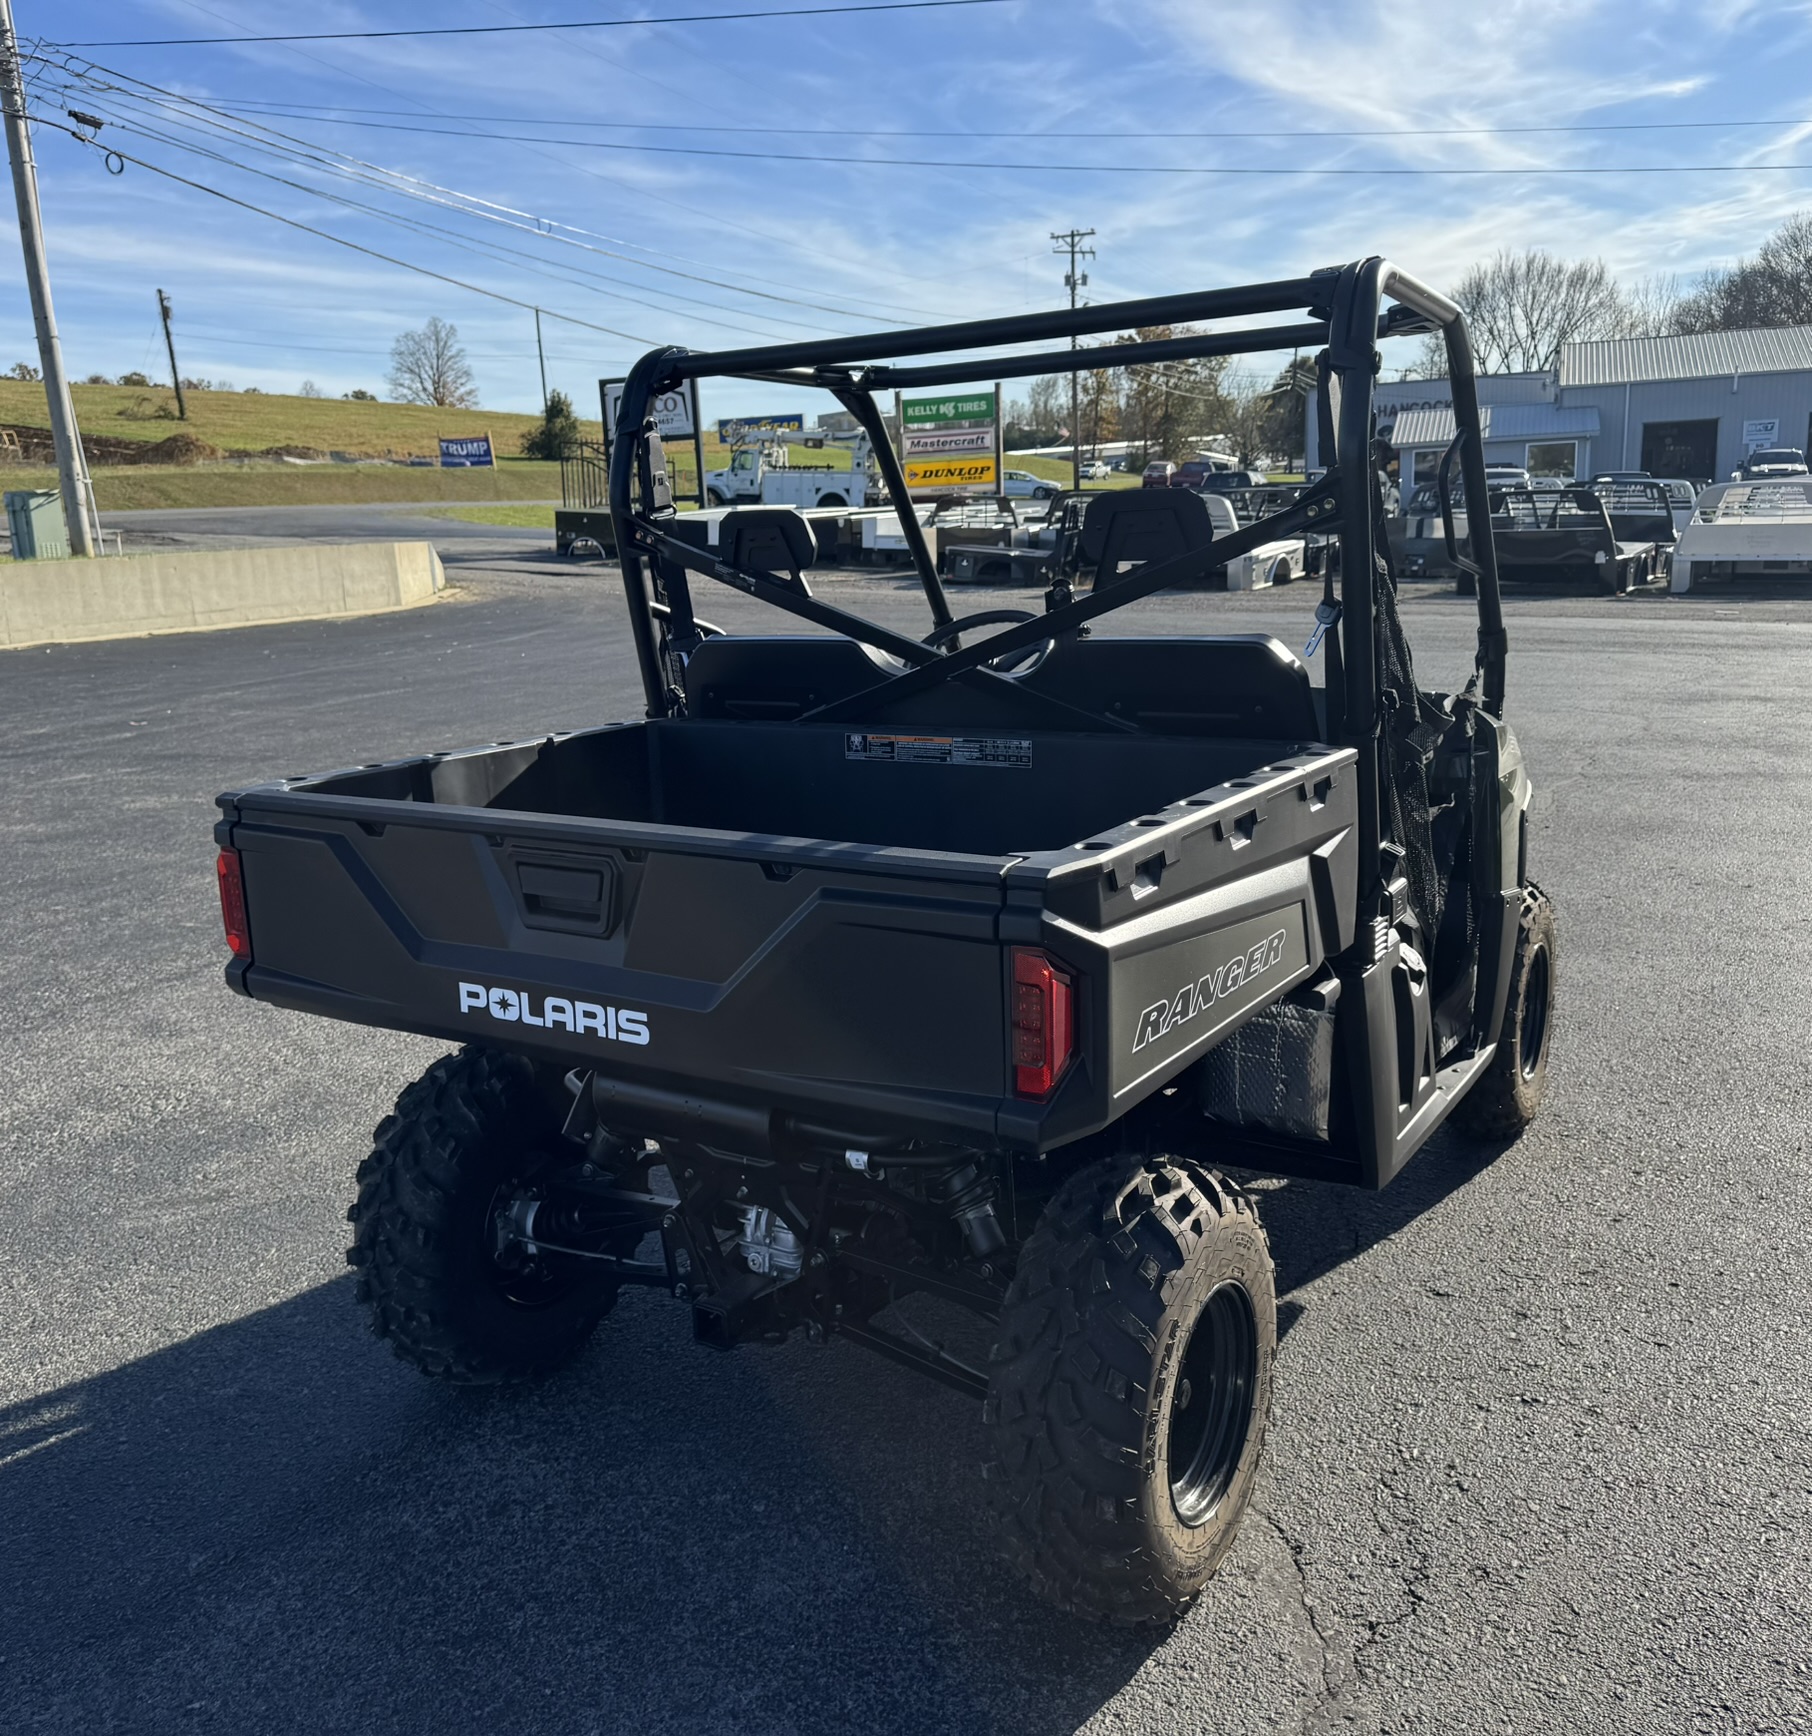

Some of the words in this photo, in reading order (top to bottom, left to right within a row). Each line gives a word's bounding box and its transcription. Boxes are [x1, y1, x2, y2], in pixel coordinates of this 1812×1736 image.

[907, 404, 937, 416] KELLY
[957, 400, 987, 412] TIRES
[440, 441, 488, 456] TRUMP
[910, 435, 985, 449] Mastercraft
[921, 466, 991, 479] DUNLOP
[1132, 929, 1287, 1053] RANGER
[458, 981, 650, 1046] POLARIS
